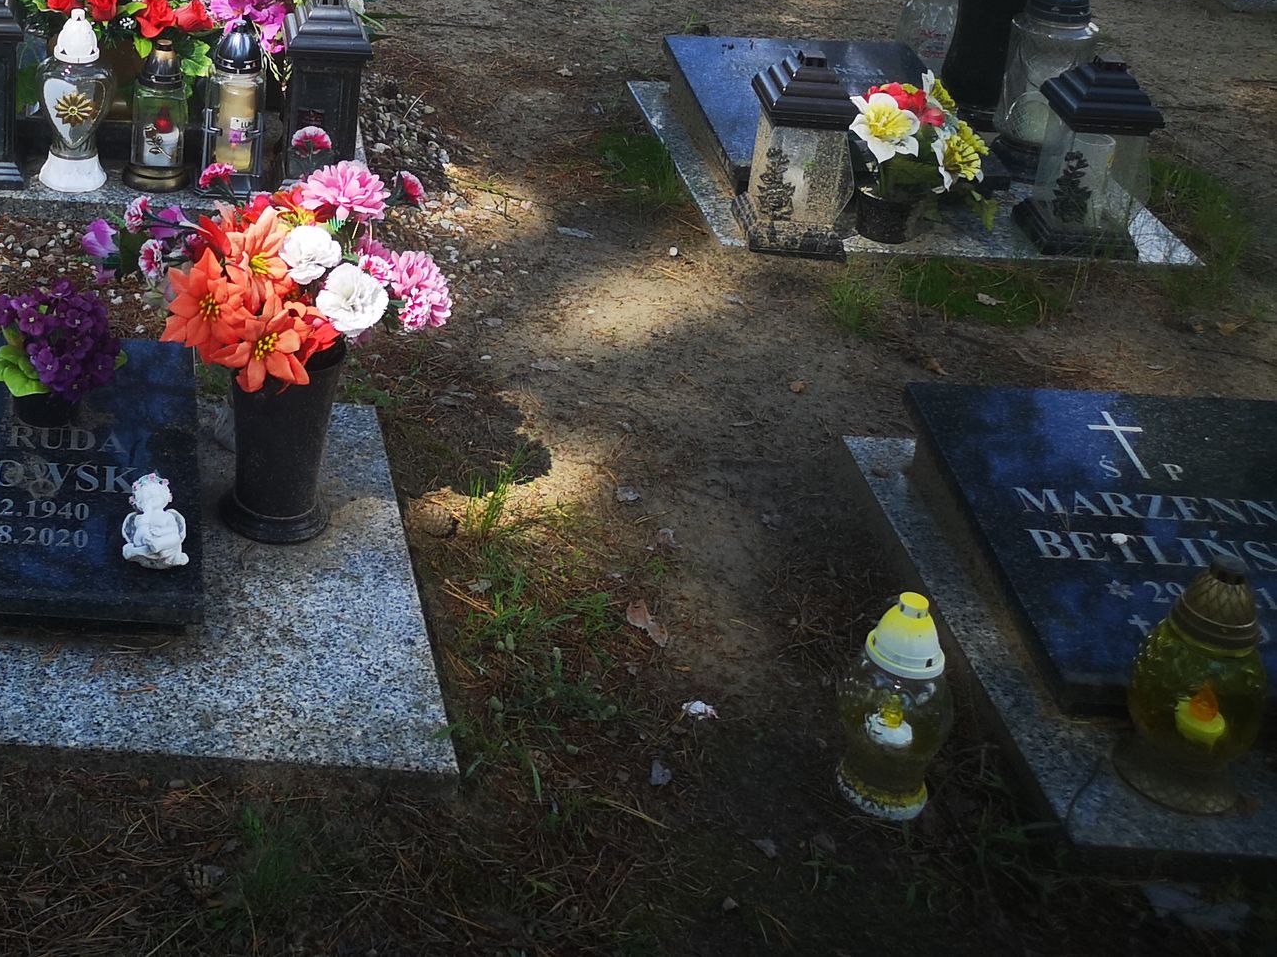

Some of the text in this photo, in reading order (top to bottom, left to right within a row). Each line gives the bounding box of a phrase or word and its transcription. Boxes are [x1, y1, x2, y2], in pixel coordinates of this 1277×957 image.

[1098, 455, 1184, 482] Ś P
[1024, 528, 1277, 572] BETLIŃS
